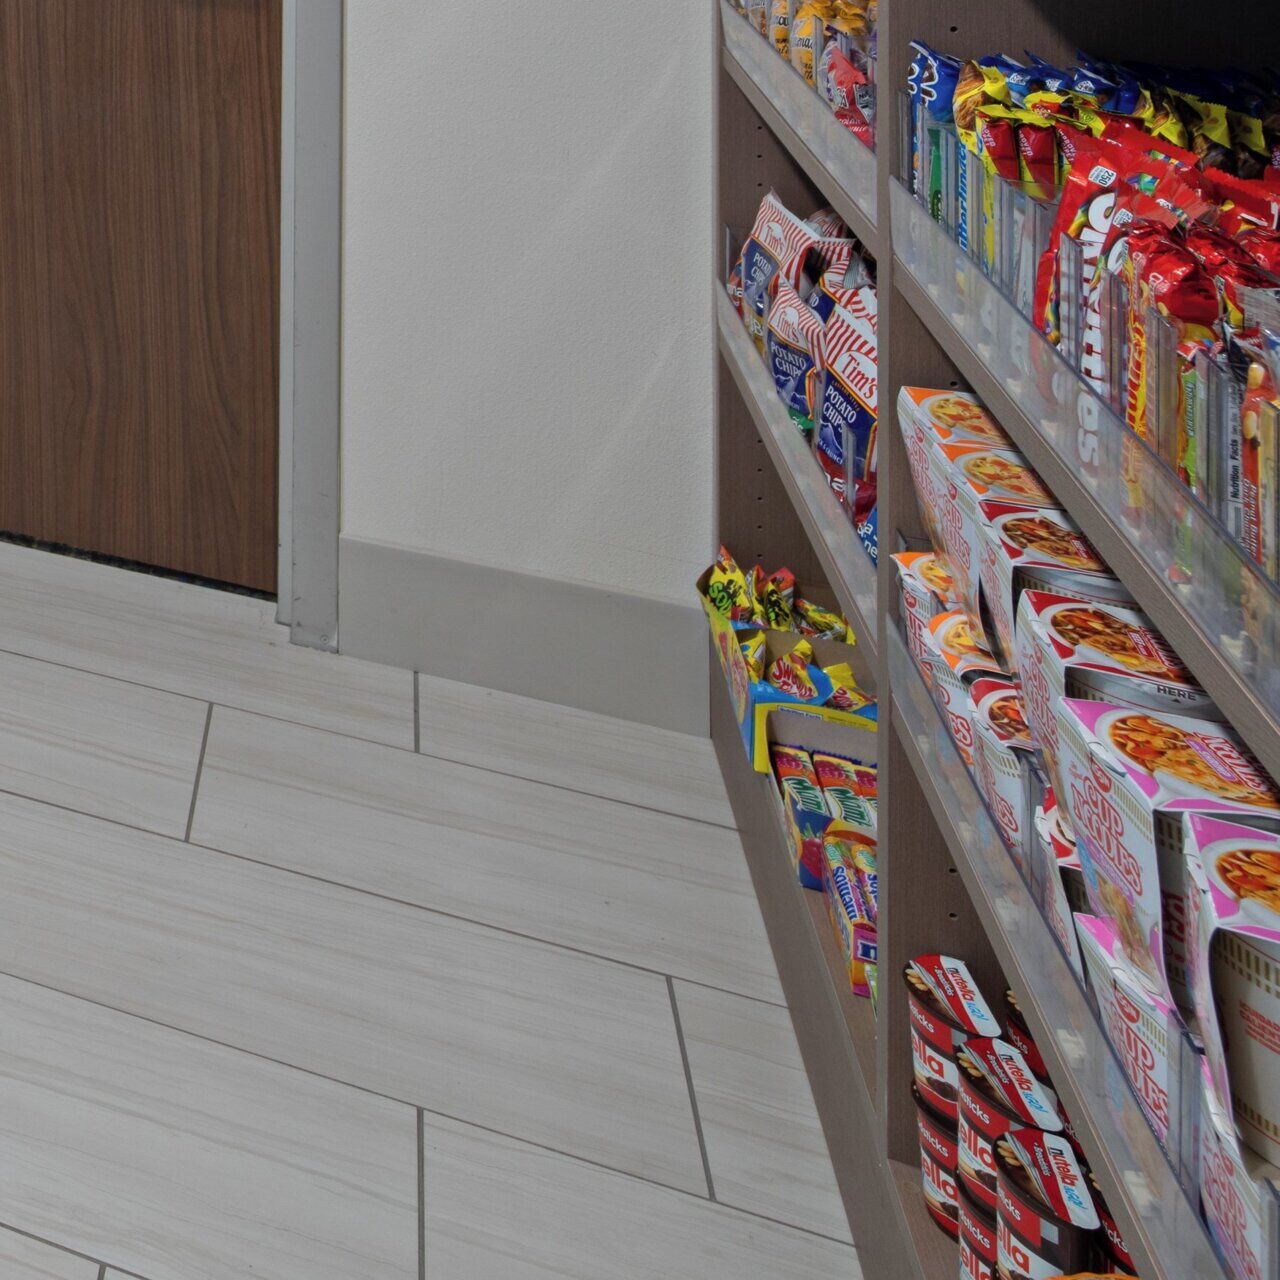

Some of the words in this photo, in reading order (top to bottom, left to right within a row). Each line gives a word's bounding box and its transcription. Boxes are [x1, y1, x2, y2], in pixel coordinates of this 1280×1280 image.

[764, 224, 785, 257] Tim's
[777, 308, 799, 343] Tim's
[771, 341, 807, 370] POTATO
[841, 353, 878, 400] Tim's
[825, 384, 857, 424] POTATO
[1229, 439, 1239, 461] Facts
[1229, 465, 1240, 499] Nutrition
[1157, 684, 1197, 701] HERE
[947, 966, 976, 1003] nutella
[1001, 1053, 1034, 1093] nutella
[1047, 1145, 1077, 1188] nutella
